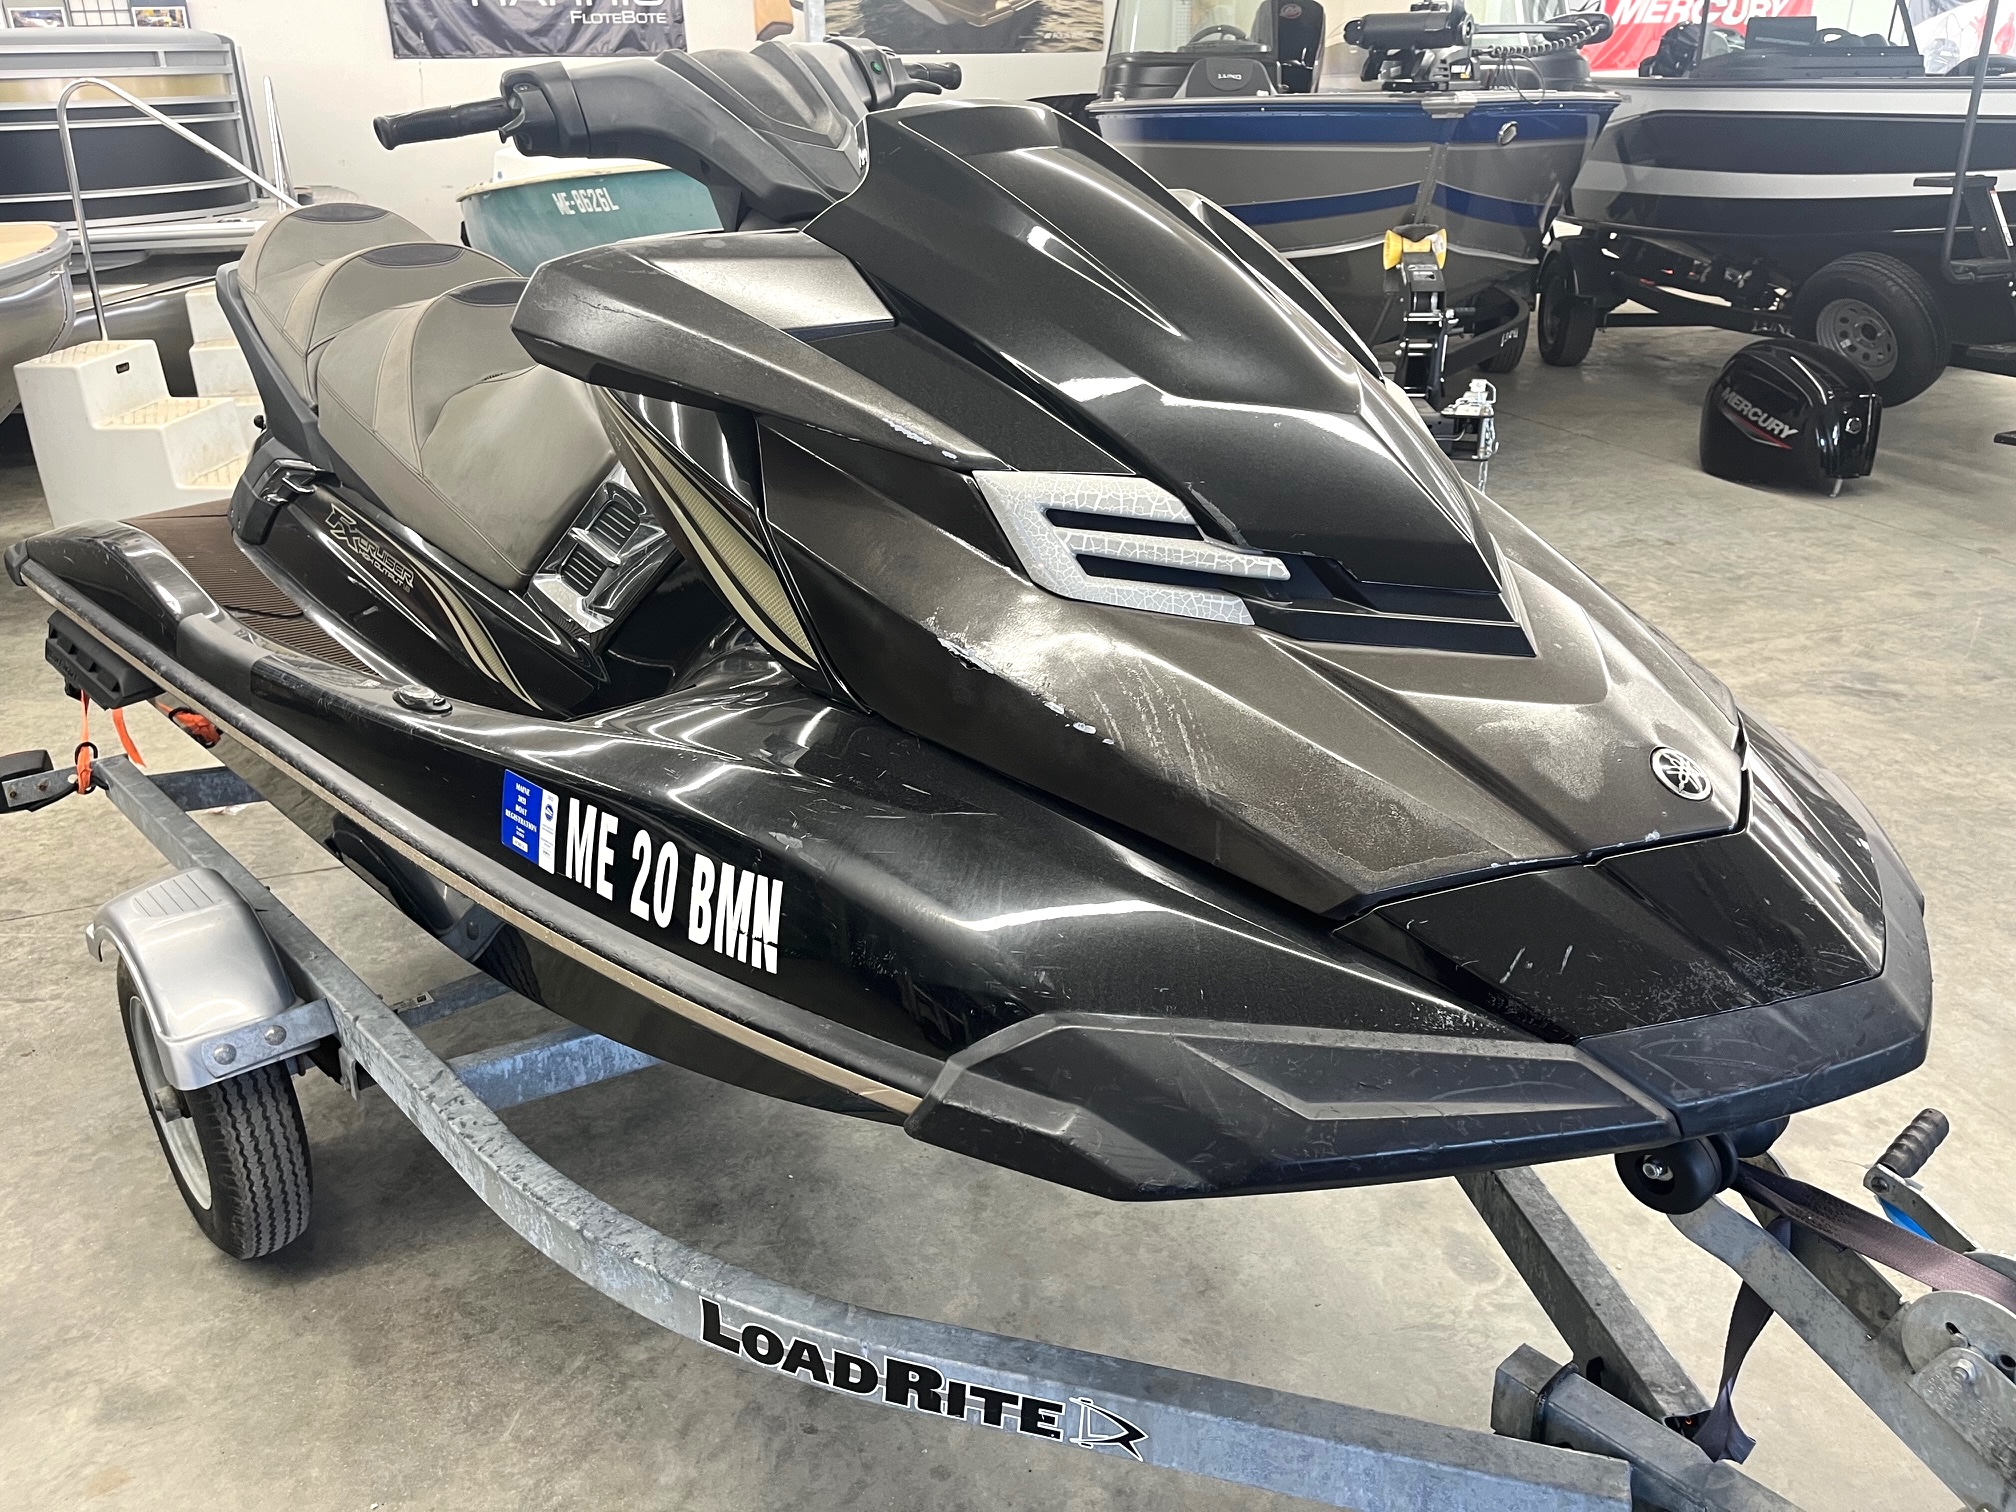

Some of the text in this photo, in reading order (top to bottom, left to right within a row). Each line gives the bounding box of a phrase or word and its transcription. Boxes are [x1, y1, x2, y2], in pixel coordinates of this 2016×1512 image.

[1721, 386, 1799, 439] MERCURY
[357, 533, 414, 589] CRUISER
[565, 797, 784, 975] ME 20 BMN
